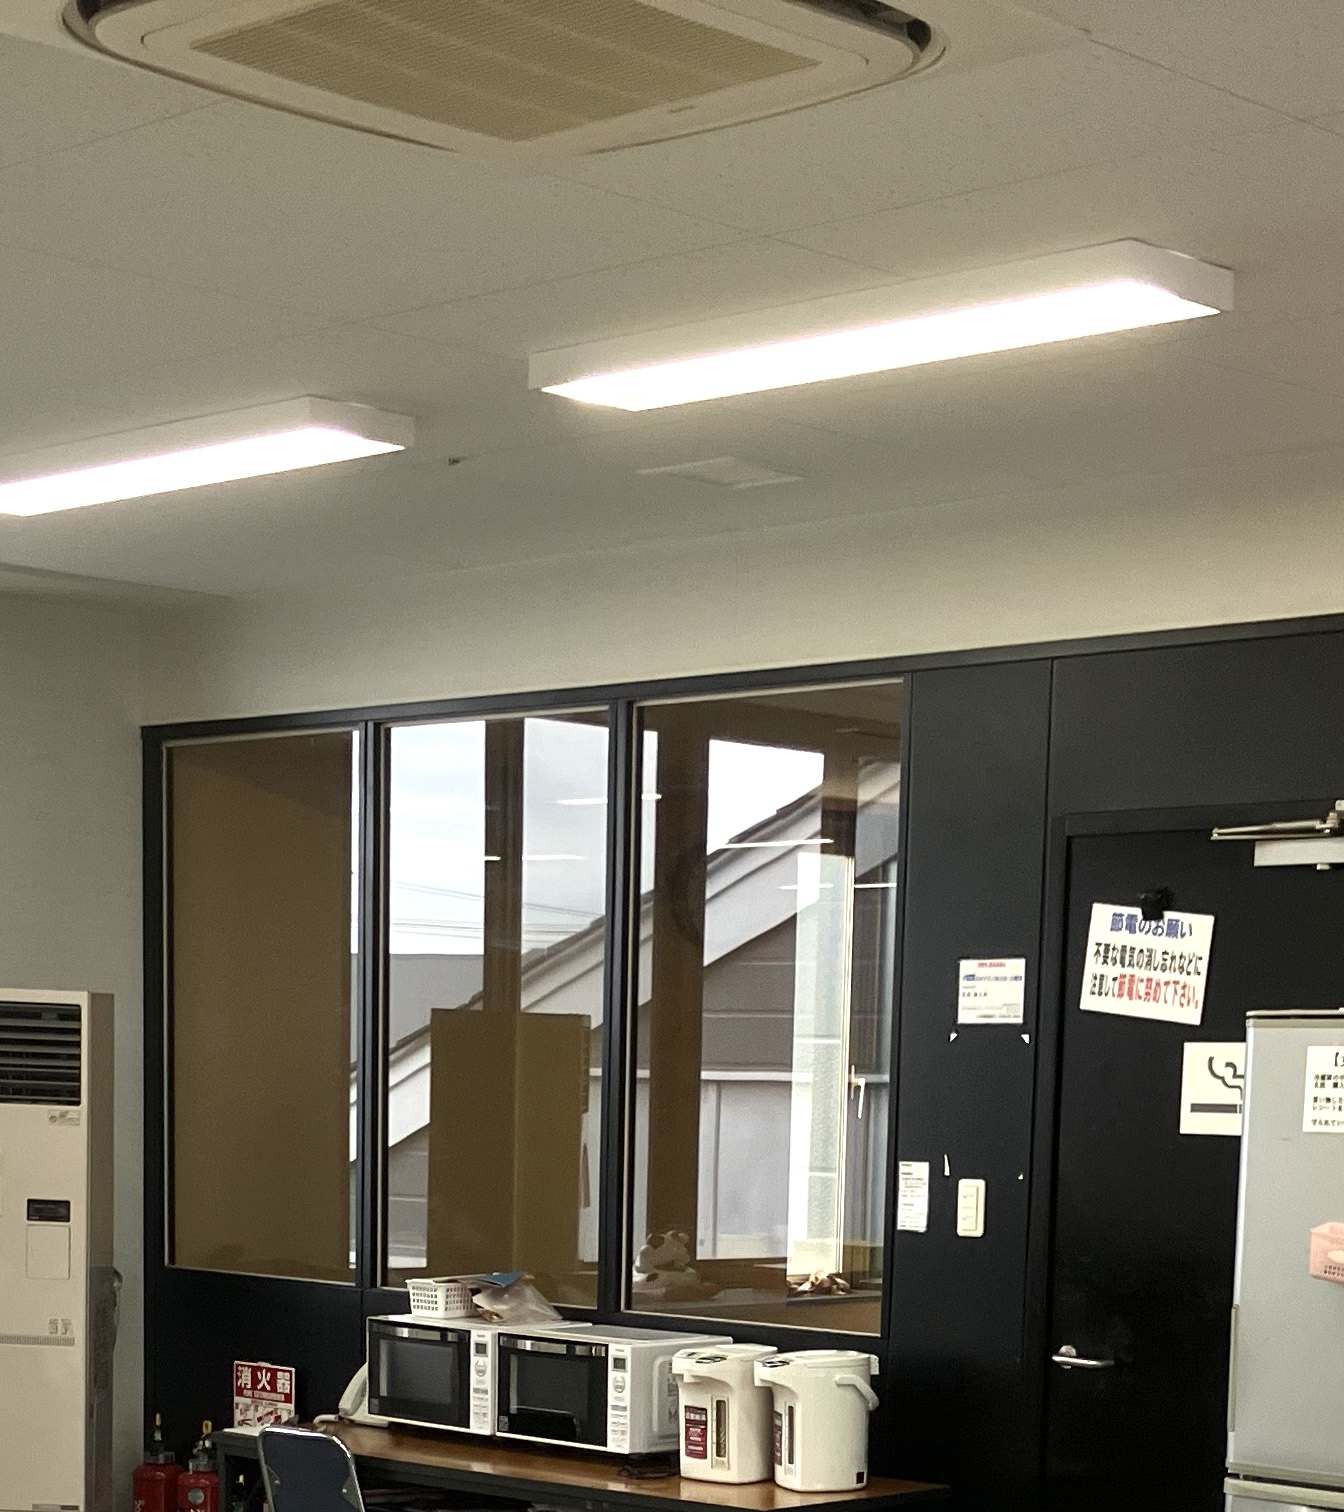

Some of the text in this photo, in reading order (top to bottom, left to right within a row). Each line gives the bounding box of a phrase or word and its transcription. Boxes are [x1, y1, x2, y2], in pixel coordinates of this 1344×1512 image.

[1110, 911, 1193, 939] 節電のお願い
[237, 1366, 291, 1394] 消火器
